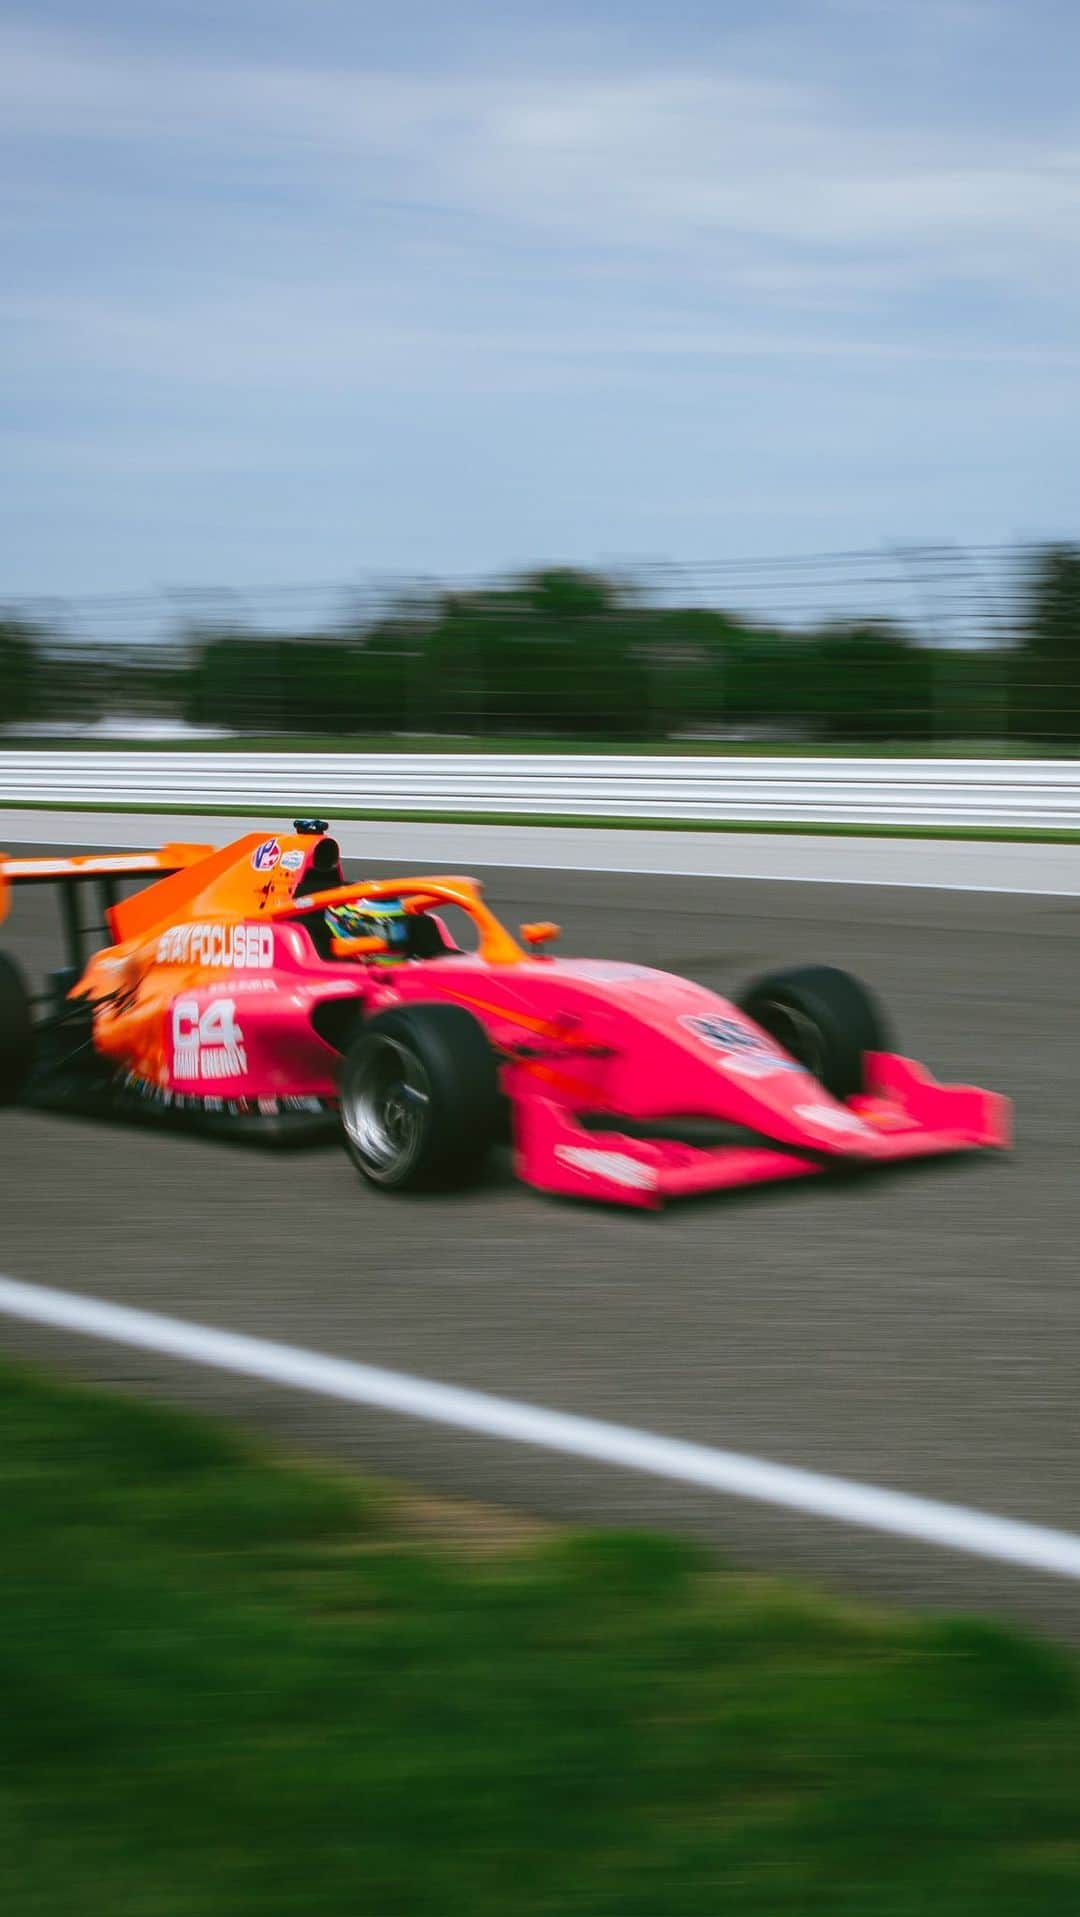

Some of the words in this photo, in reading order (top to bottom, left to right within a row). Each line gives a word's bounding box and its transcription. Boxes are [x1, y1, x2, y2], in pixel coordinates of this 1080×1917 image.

[157, 925, 193, 963] STAY
[191, 925, 274, 968] FOCUSED
[173, 999, 244, 1048] C4
